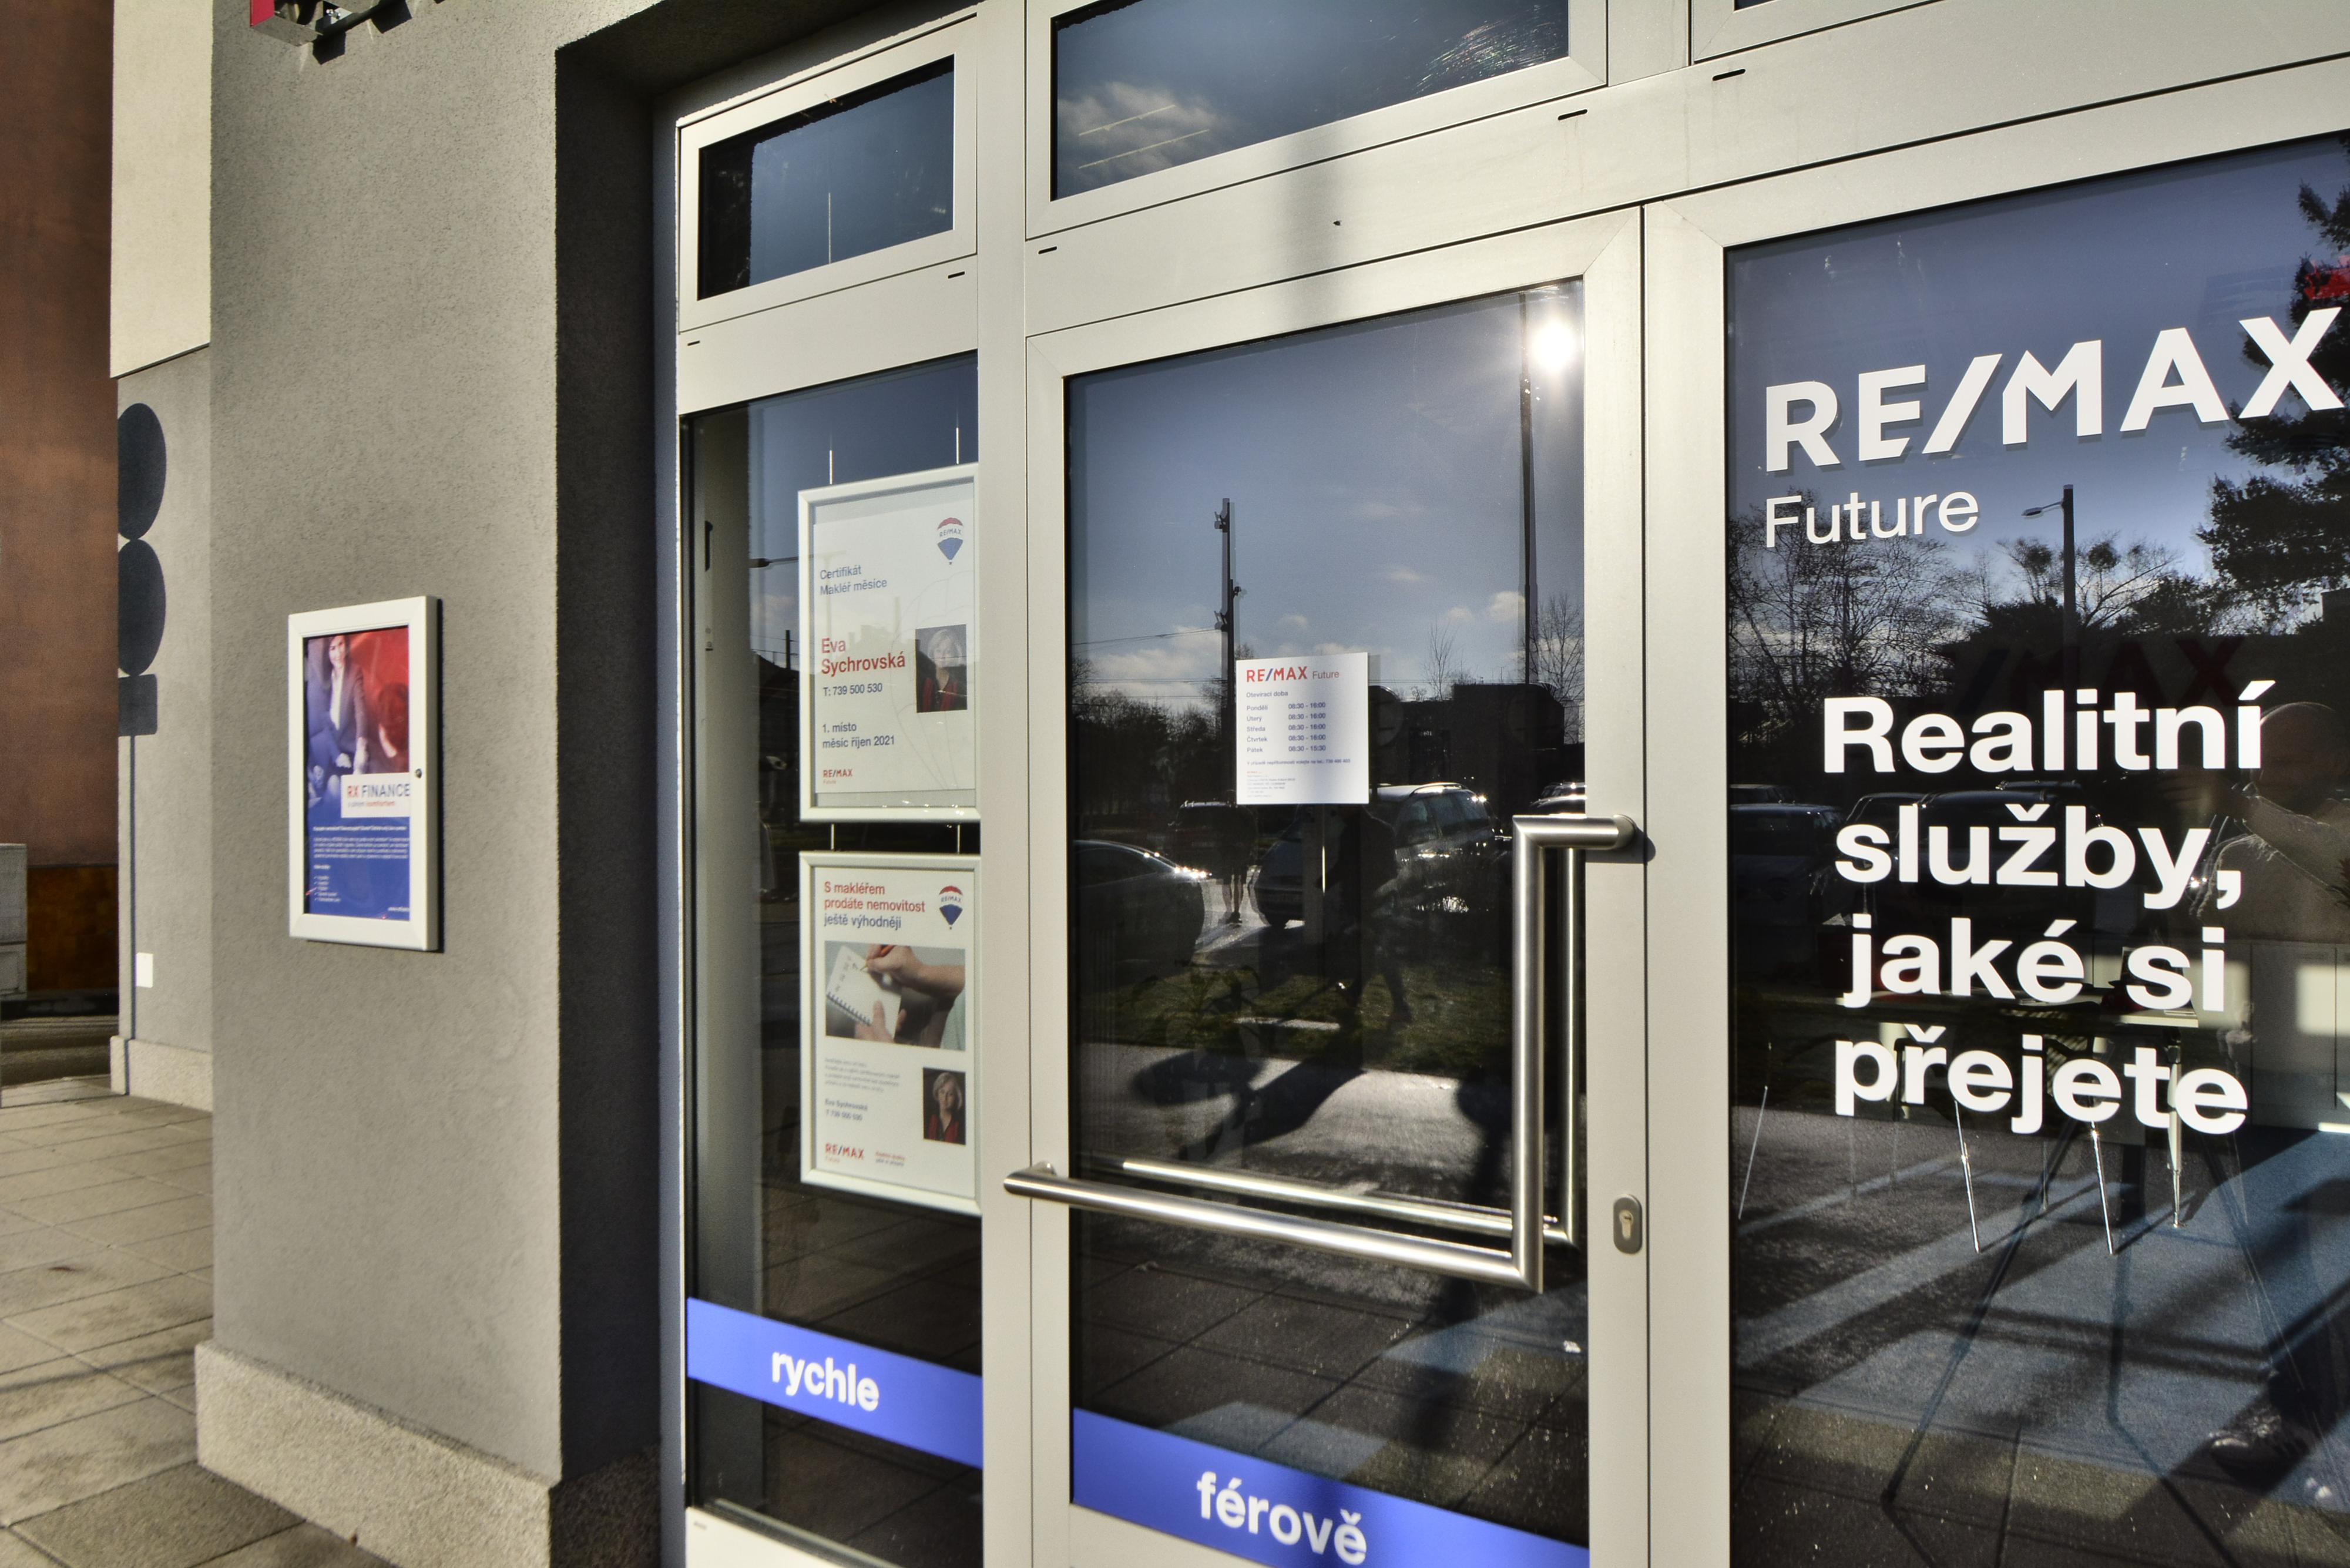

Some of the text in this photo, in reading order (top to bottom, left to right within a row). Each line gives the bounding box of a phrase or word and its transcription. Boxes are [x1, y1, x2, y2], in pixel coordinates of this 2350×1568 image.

[1766, 306, 2345, 472] RE/MAX
[1766, 490, 1979, 548] Future
[820, 565, 862, 579] Certifikát
[820, 579, 887, 595] Makléř měsíce
[821, 638, 846, 653] Eva
[821, 651, 905, 677] Sychrovská
[1247, 666, 1340, 683] RE/MAX Future
[823, 683, 882, 696] T: 739 500 530
[822, 722, 857, 733] 1. místo
[1824, 680, 2276, 774] Realitní
[822, 736, 895, 748] měsíc říjen 2021
[823, 769, 853, 778] RE/MAX
[361, 783, 410, 798] FINANCE
[1835, 804, 2241, 910] služby,
[824, 881, 885, 895] S makléřem
[824, 898, 925, 912] prodáte nemovitost
[824, 913, 902, 931] ještě výhodněji
[1842, 914, 2225, 1012] jaké si
[1835, 1025, 2248, 1134] přejete
[771, 1351, 879, 1411] rychle
[1197, 1470, 1367, 1566] férově
